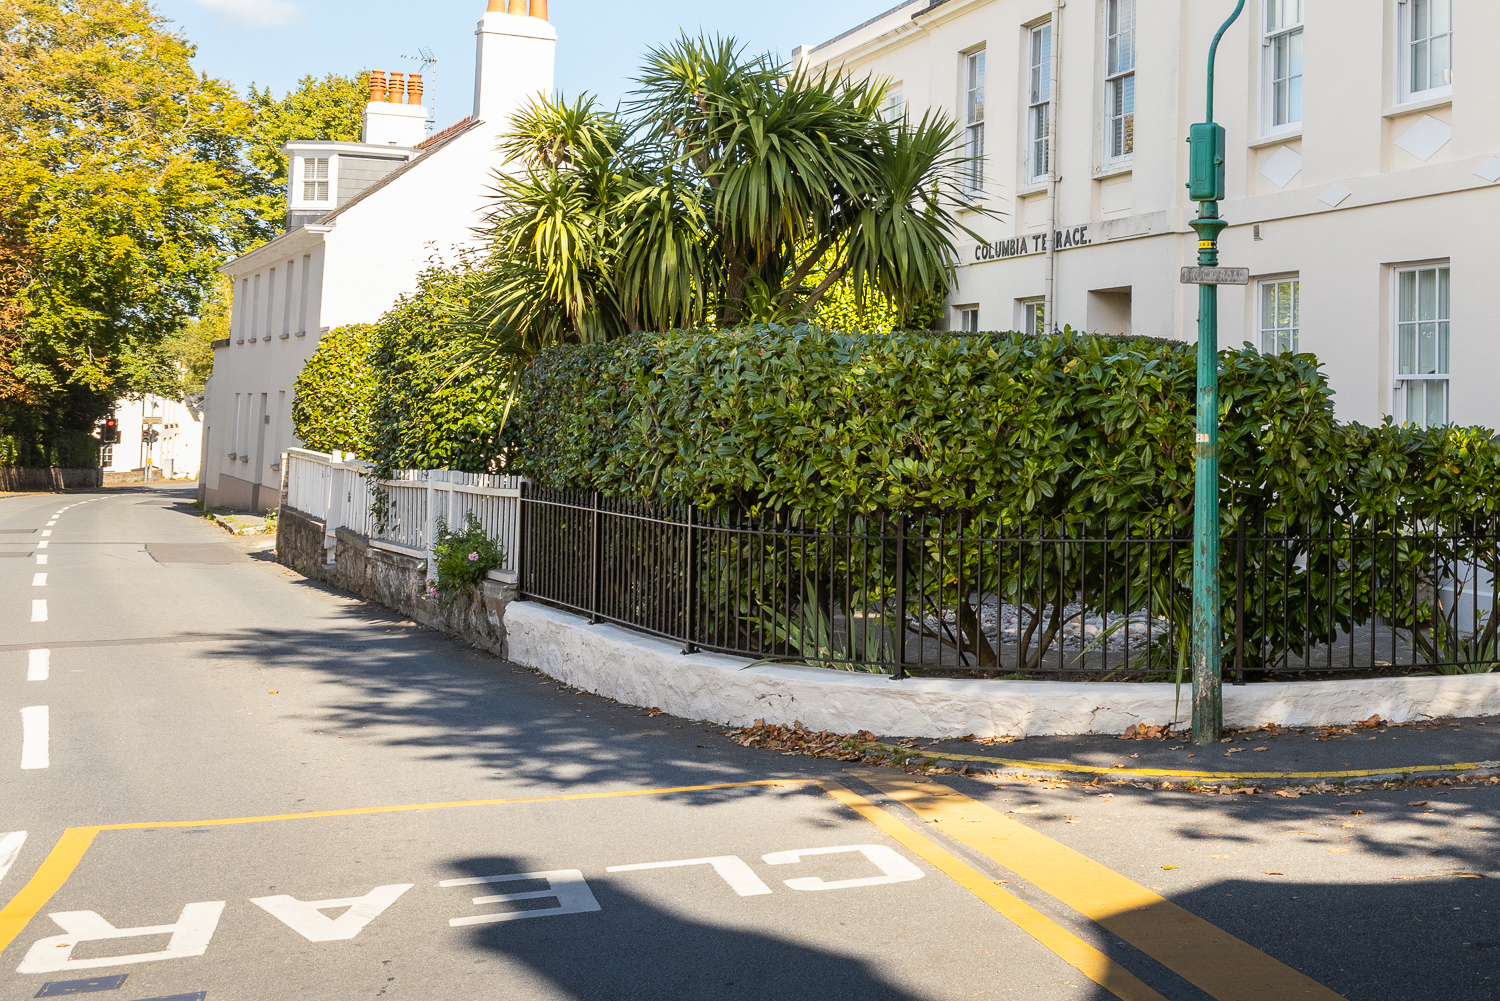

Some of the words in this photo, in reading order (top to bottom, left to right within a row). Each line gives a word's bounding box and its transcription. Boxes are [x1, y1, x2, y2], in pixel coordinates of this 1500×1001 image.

[975, 237, 1028, 261] COLUMBIA
[1032, 226, 1092, 252] TERACE.
[16, 844, 926, 974] CLEAR
